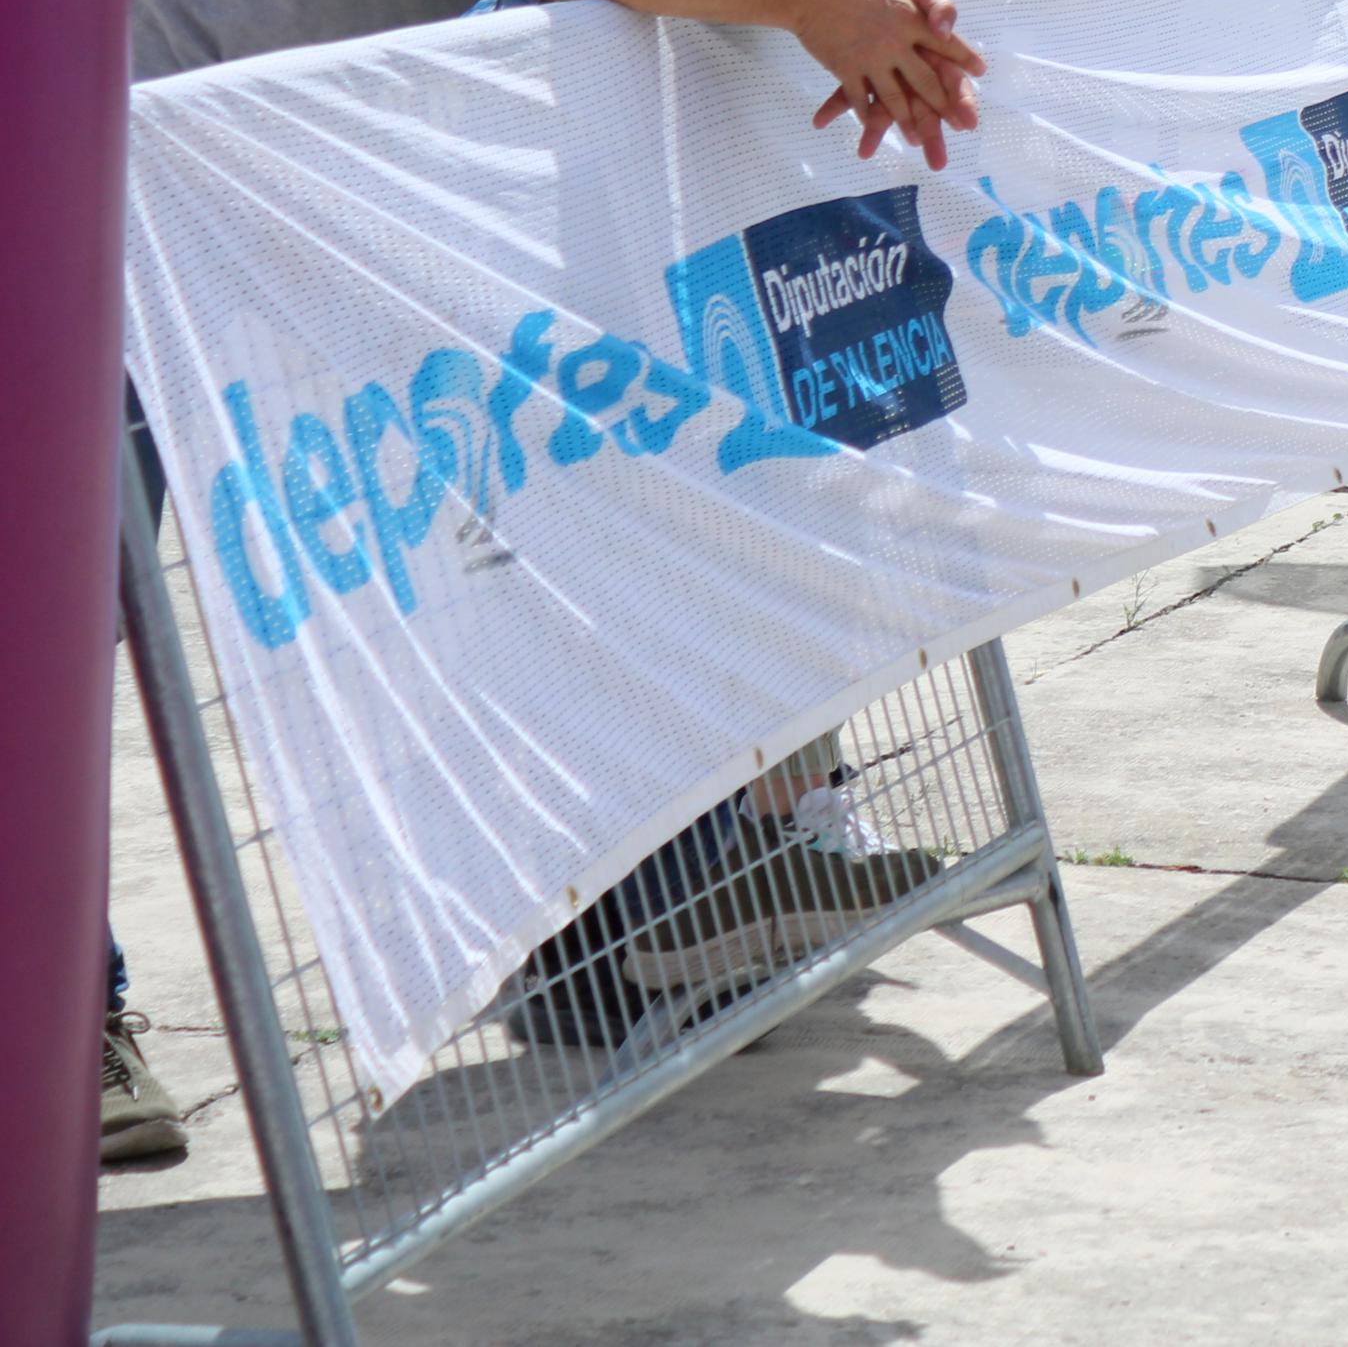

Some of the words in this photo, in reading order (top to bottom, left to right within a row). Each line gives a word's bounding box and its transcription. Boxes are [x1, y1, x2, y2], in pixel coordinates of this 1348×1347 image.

[762, 232, 908, 338] Diputación
[792, 359, 838, 430] DE
[828, 311, 952, 410] PALENCIA
